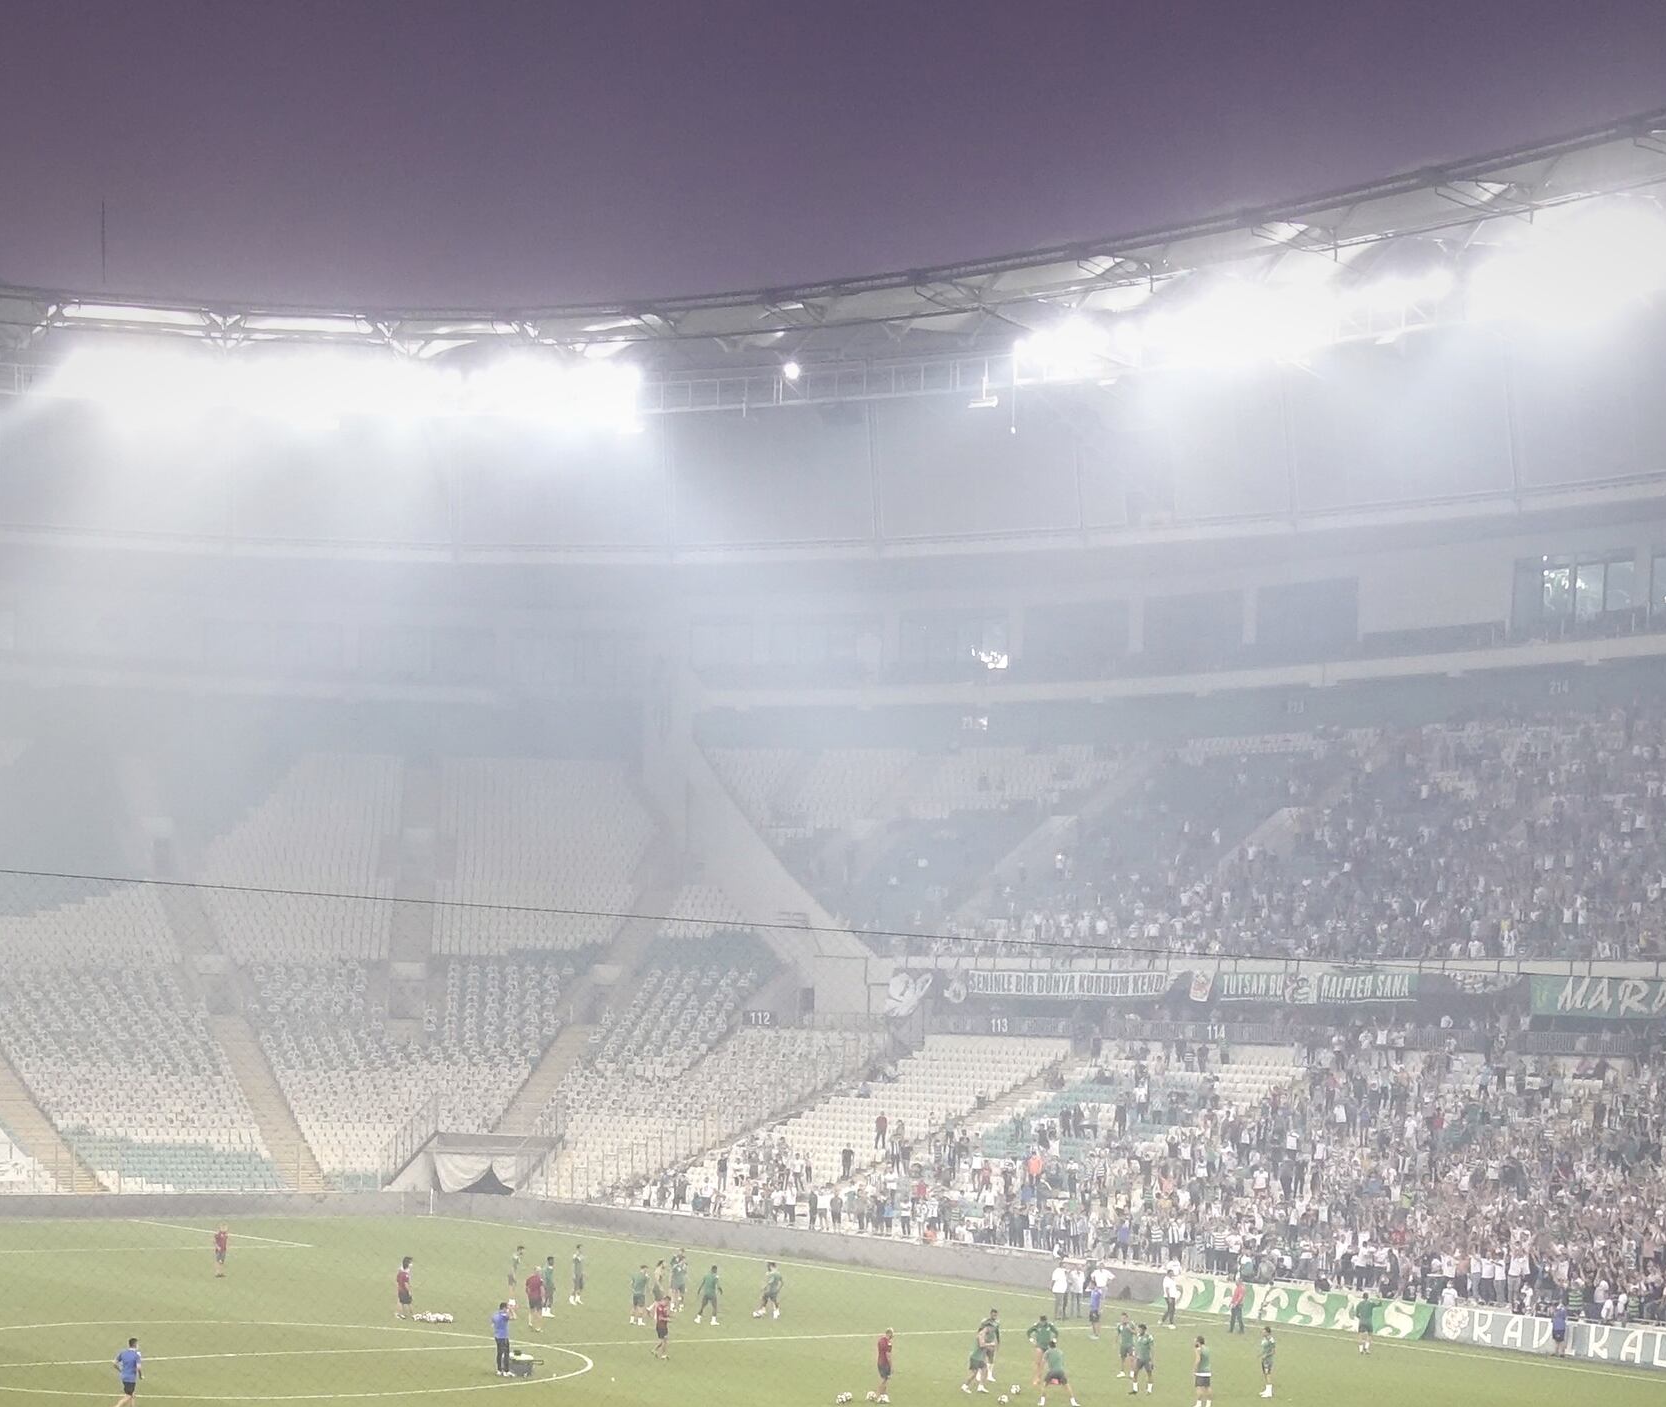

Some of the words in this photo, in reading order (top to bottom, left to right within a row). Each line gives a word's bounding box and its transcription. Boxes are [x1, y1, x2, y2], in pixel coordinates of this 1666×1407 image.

[750, 1012, 771, 1025] 112
[990, 1018, 1009, 1033] 113
[1206, 1024, 1226, 1040] 114
